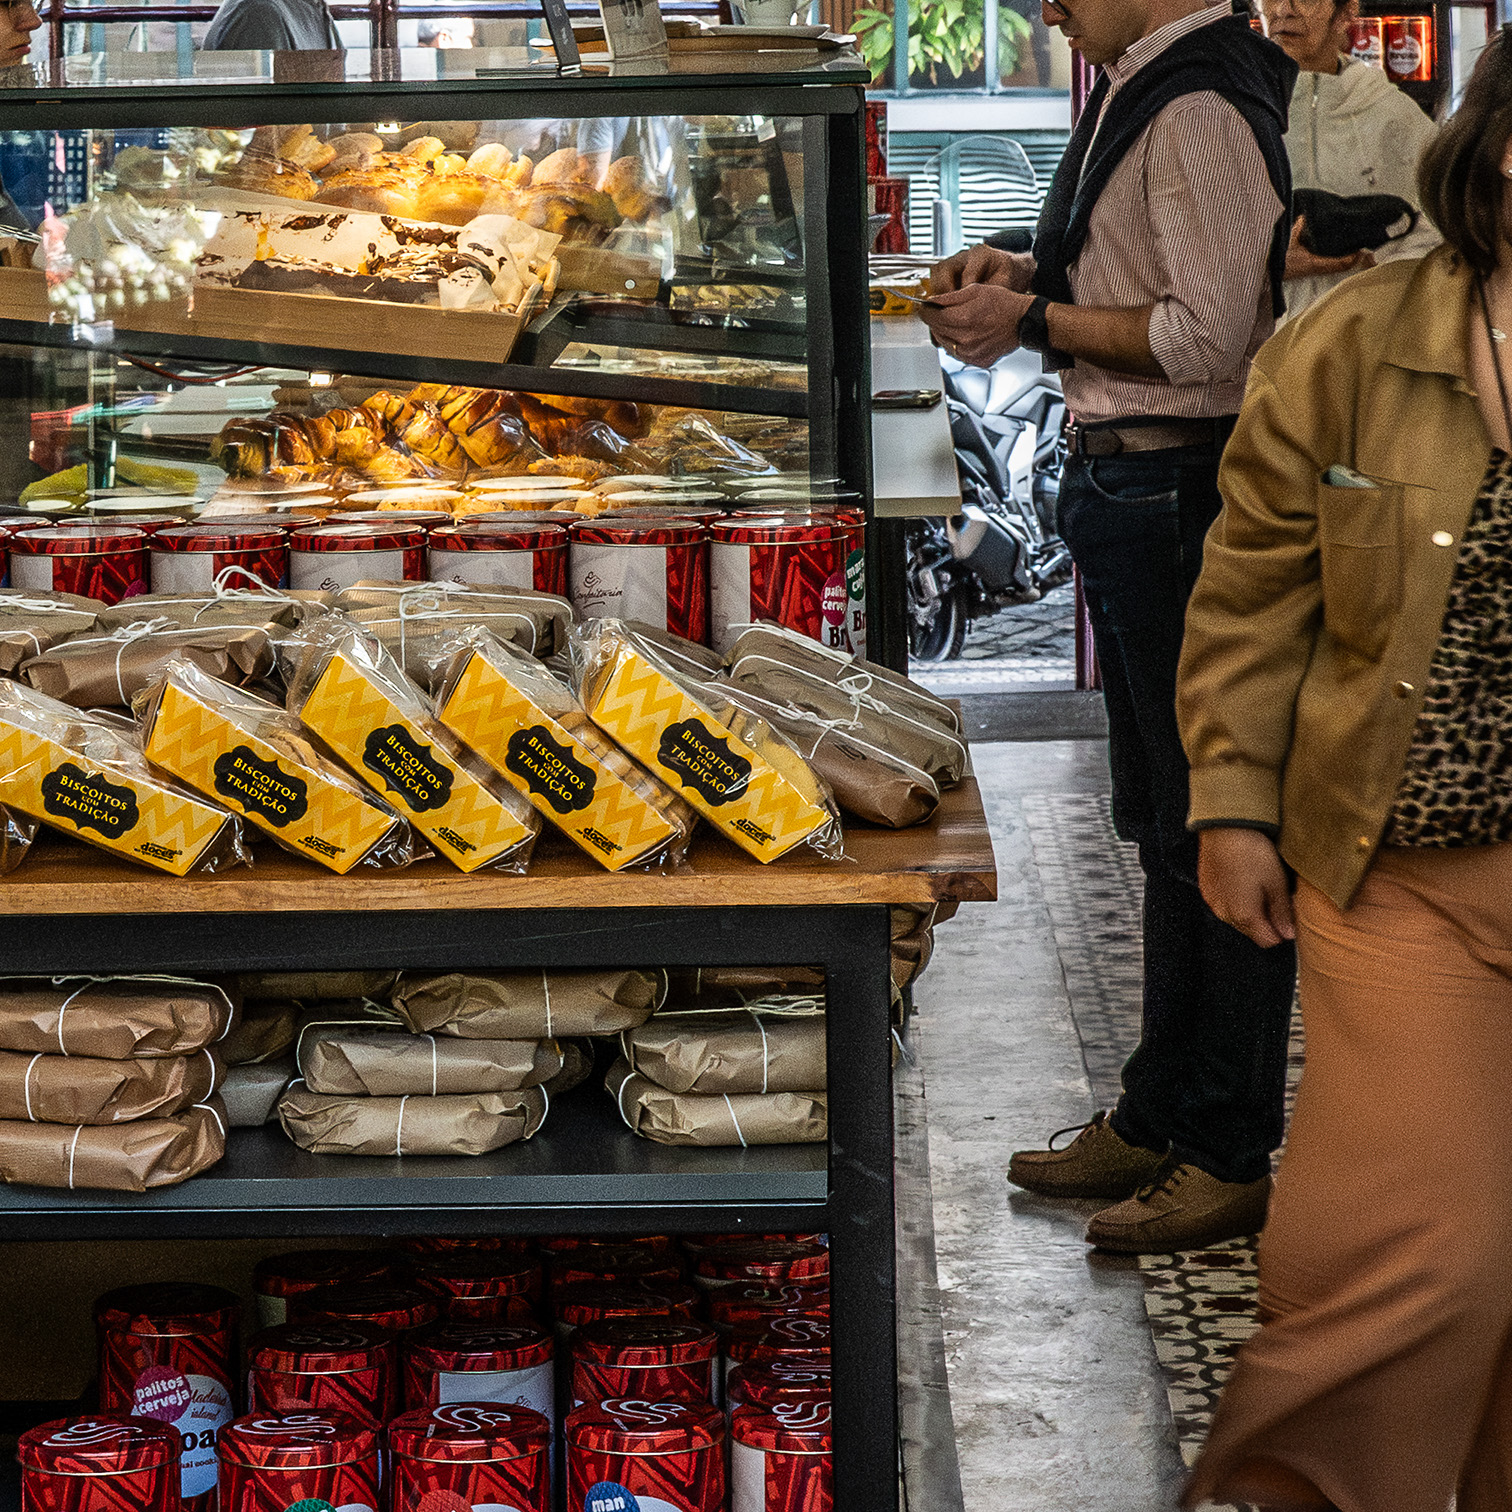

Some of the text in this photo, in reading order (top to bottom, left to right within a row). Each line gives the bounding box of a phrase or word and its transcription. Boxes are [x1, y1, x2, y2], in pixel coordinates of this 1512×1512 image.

[377, 749, 429, 800] TRADIÇÃO
[387, 735, 442, 789] BISCOITOS
[518, 751, 572, 800] TRADIÇÃO
[528, 737, 586, 789] BISCOITOS
[671, 744, 726, 793] TRADIÇÃO
[682, 730, 740, 781] BISCOITOS
[60, 775, 128, 811] BISCOITOS
[227, 773, 287, 814] TRADIÇÃO
[234, 758, 297, 801] BISCOITOS
[55, 792, 119, 825] TRADIÇÃO
[136, 1376, 184, 1402] palitos
[139, 1390, 190, 1414] cerveja
[592, 1496, 625, 1512] man
